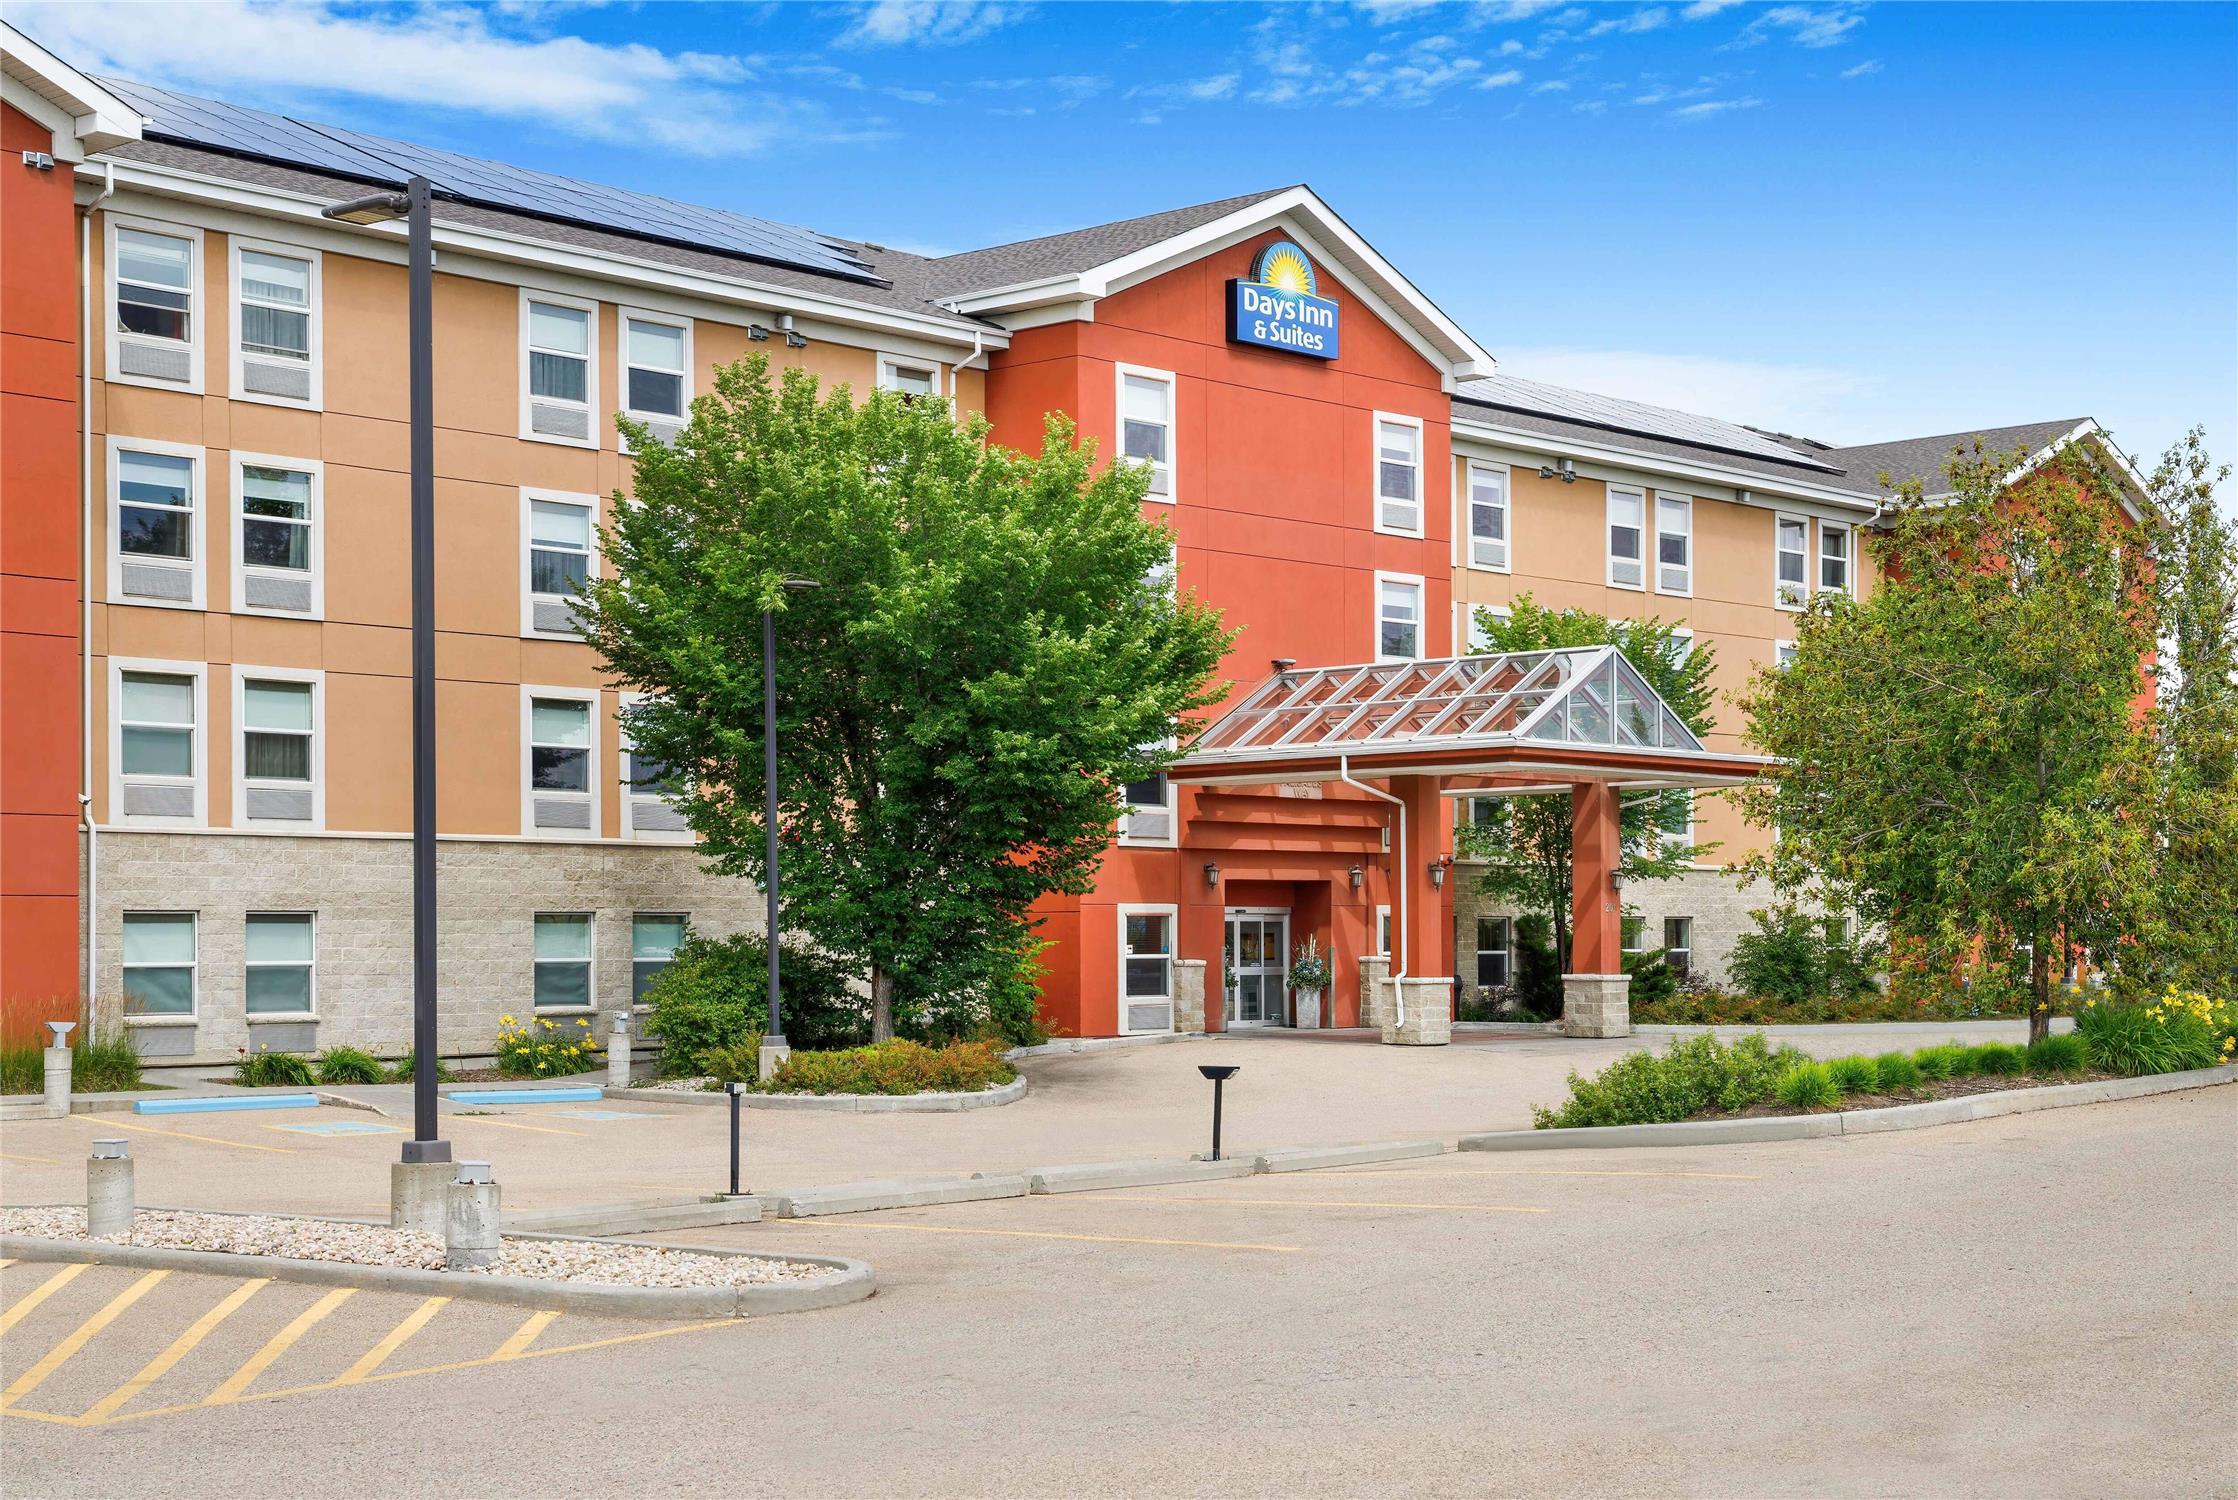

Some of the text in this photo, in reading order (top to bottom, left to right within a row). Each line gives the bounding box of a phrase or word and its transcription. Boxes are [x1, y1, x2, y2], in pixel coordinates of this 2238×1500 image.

[1243, 287, 1333, 328] Days Inn
[1254, 320, 1324, 351] & Suites
